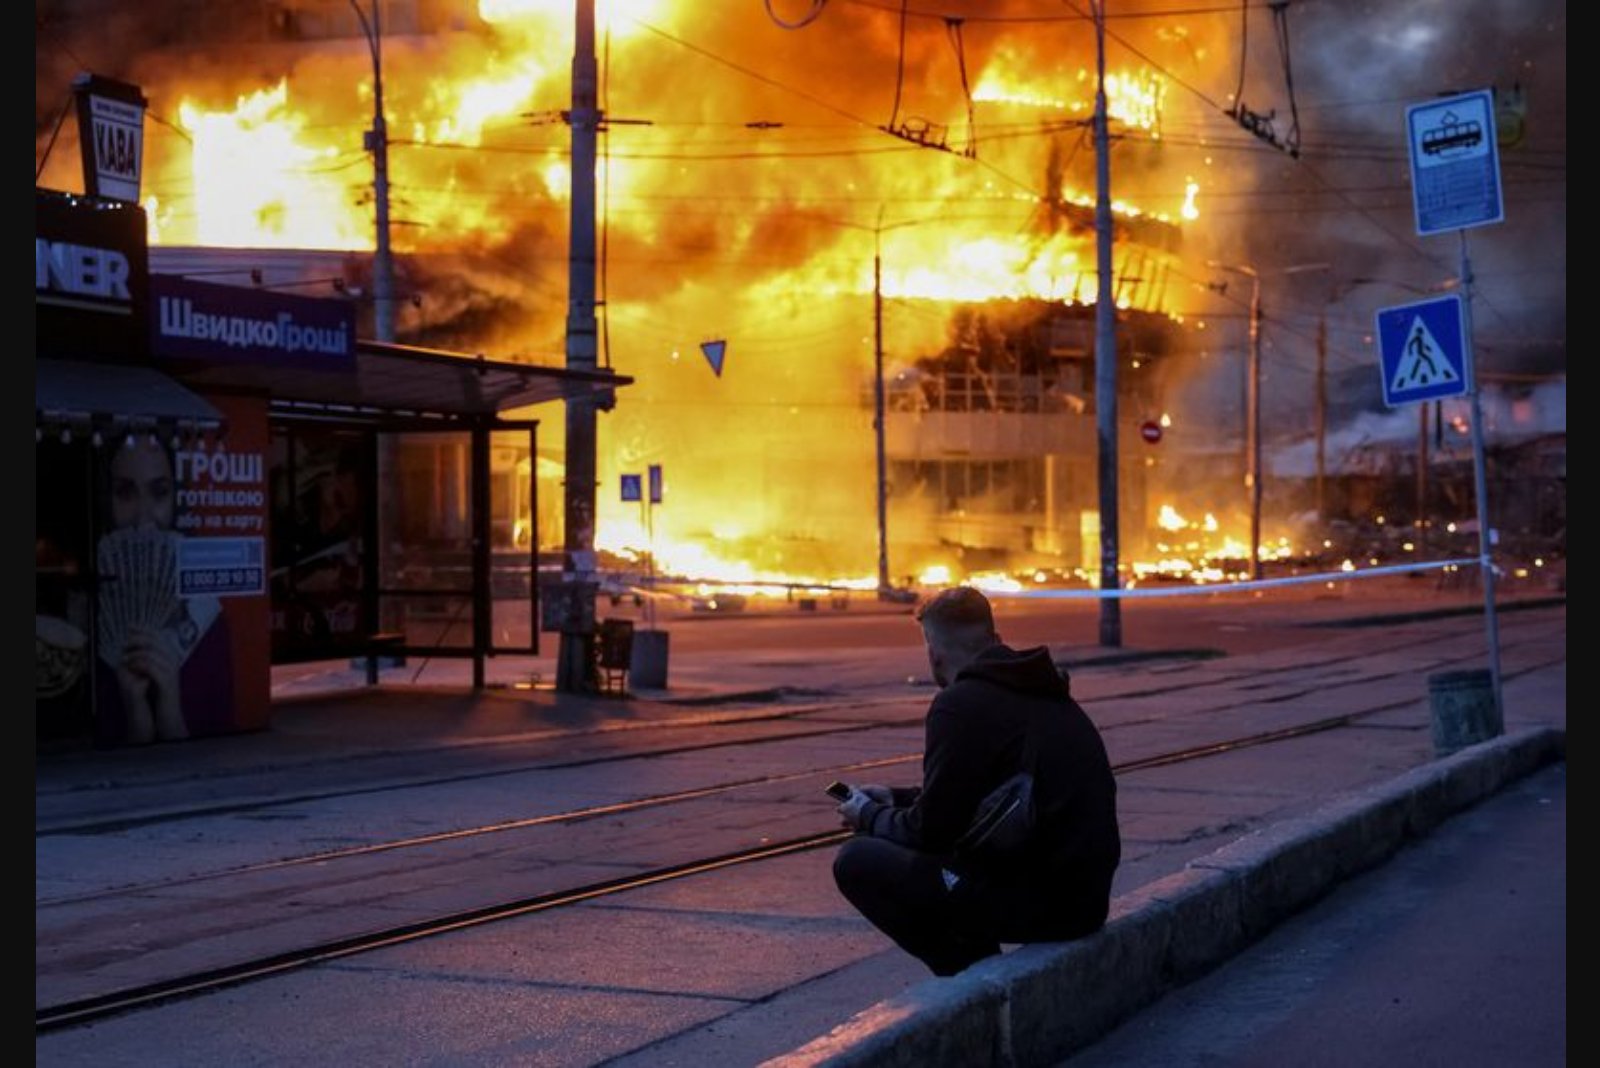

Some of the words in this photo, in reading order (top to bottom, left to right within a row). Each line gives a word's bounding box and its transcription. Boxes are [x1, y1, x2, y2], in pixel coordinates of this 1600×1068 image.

[95, 121, 137, 177] КАВА
[160, 296, 348, 355] ШвидкоГроші
[175, 452, 263, 483] ГРОШІ
